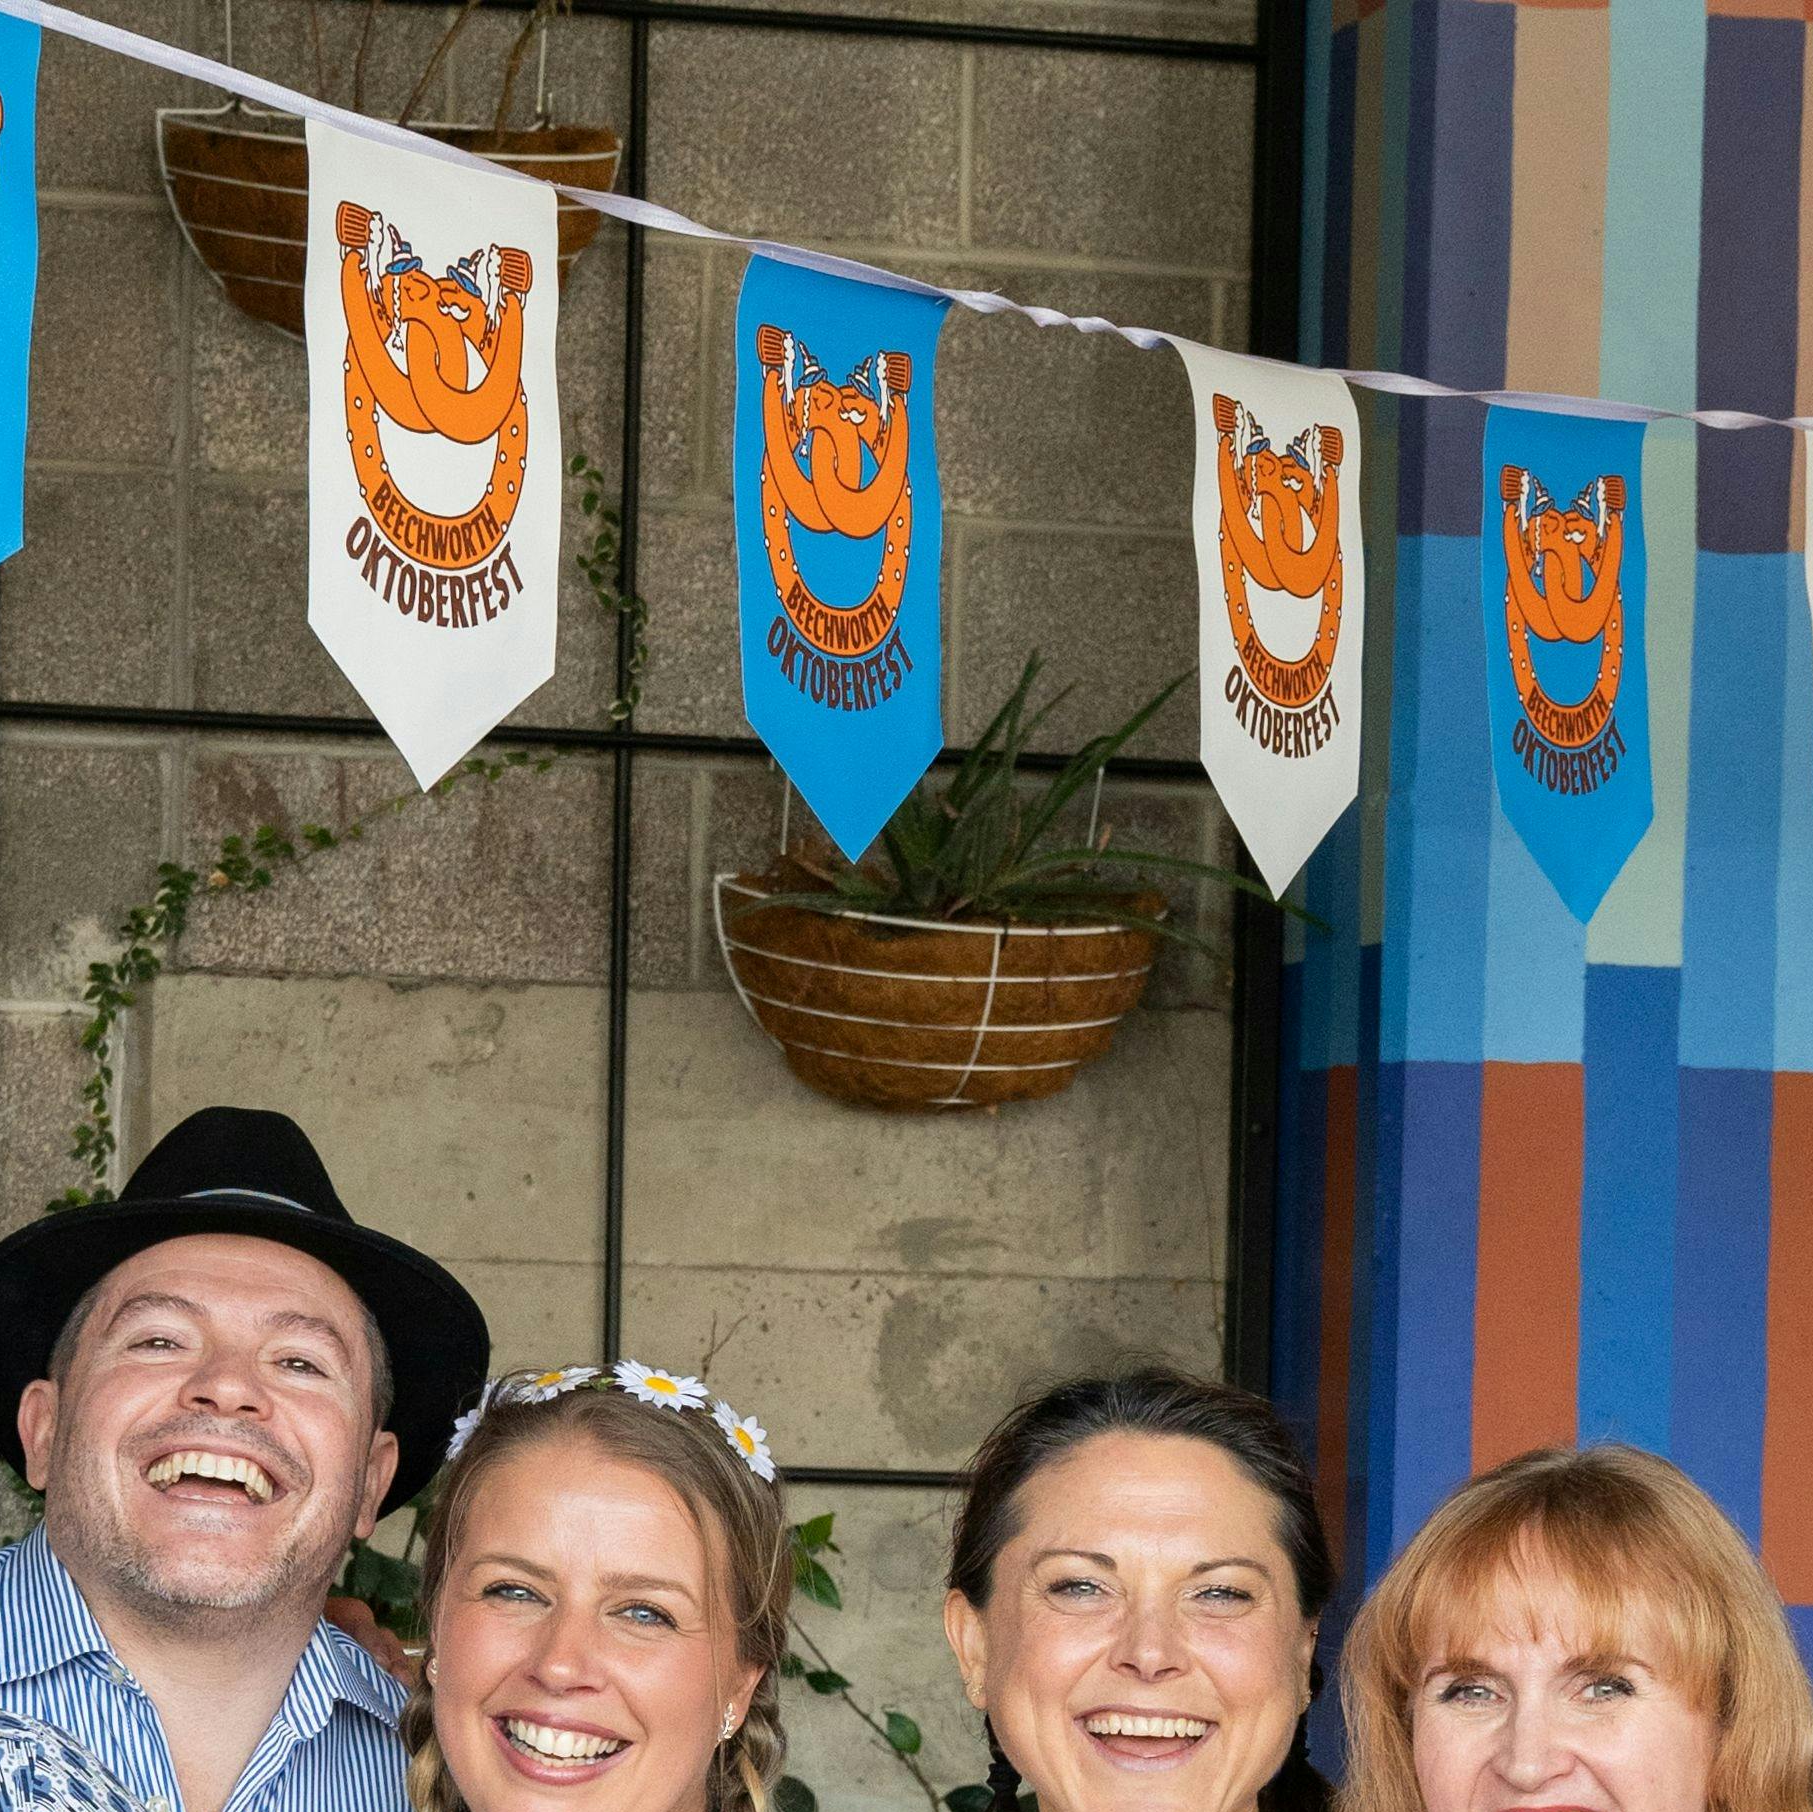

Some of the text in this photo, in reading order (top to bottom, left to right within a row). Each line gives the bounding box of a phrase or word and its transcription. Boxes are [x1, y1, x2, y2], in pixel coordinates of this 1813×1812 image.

[371, 478, 500, 564] BEECHWORTH
[345, 516, 525, 629] OKTOBERFEST
[788, 578, 893, 651] BEECHWORTH
[767, 615, 915, 713] OKTOBERFEST
[1243, 631, 1326, 701] BEECHWORTH
[1225, 664, 1341, 759] OKTOBERFEST
[1526, 685, 1610, 743] BEECHWORTH
[1511, 716, 1627, 797] OKTOBERFEST
